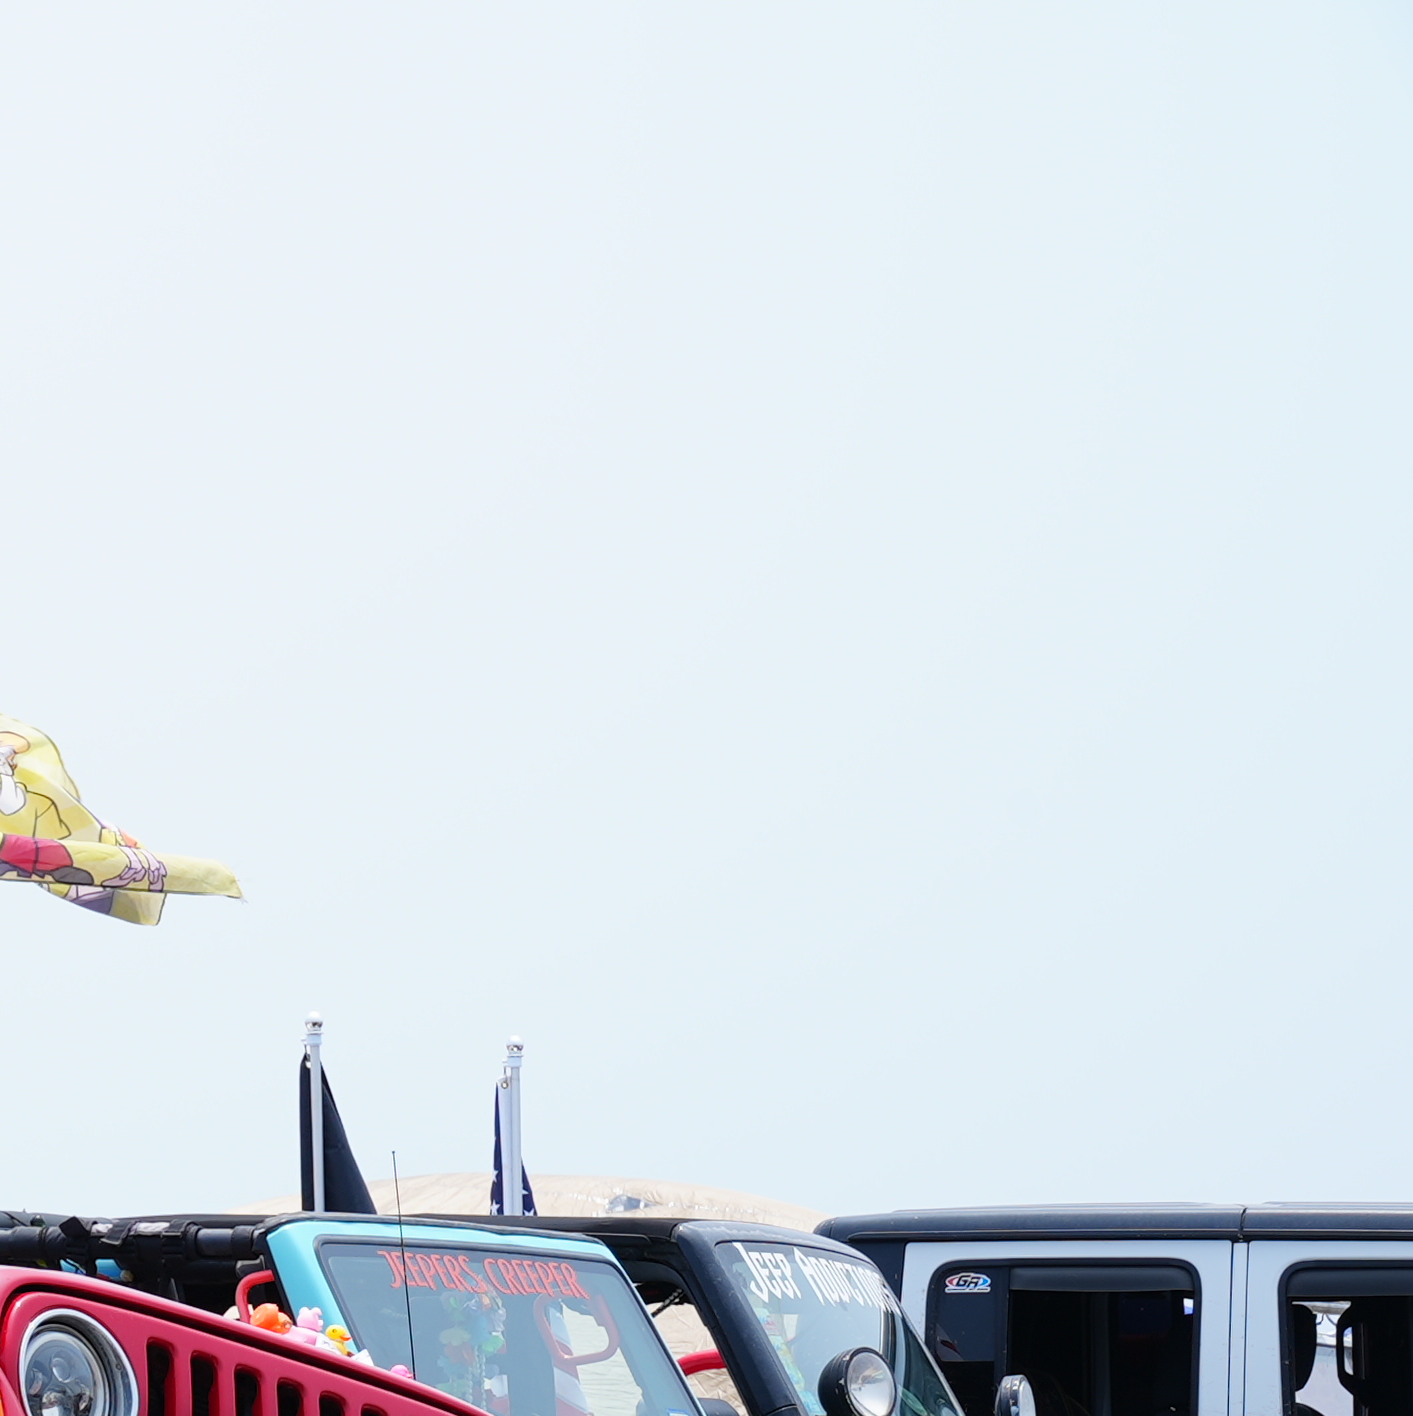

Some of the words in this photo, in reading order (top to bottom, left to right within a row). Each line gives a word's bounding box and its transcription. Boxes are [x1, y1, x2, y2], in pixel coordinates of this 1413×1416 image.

[377, 1250, 488, 1294] JEEPERS
[483, 1258, 590, 1300] CREEPER
[732, 1242, 802, 1303] JEEP
